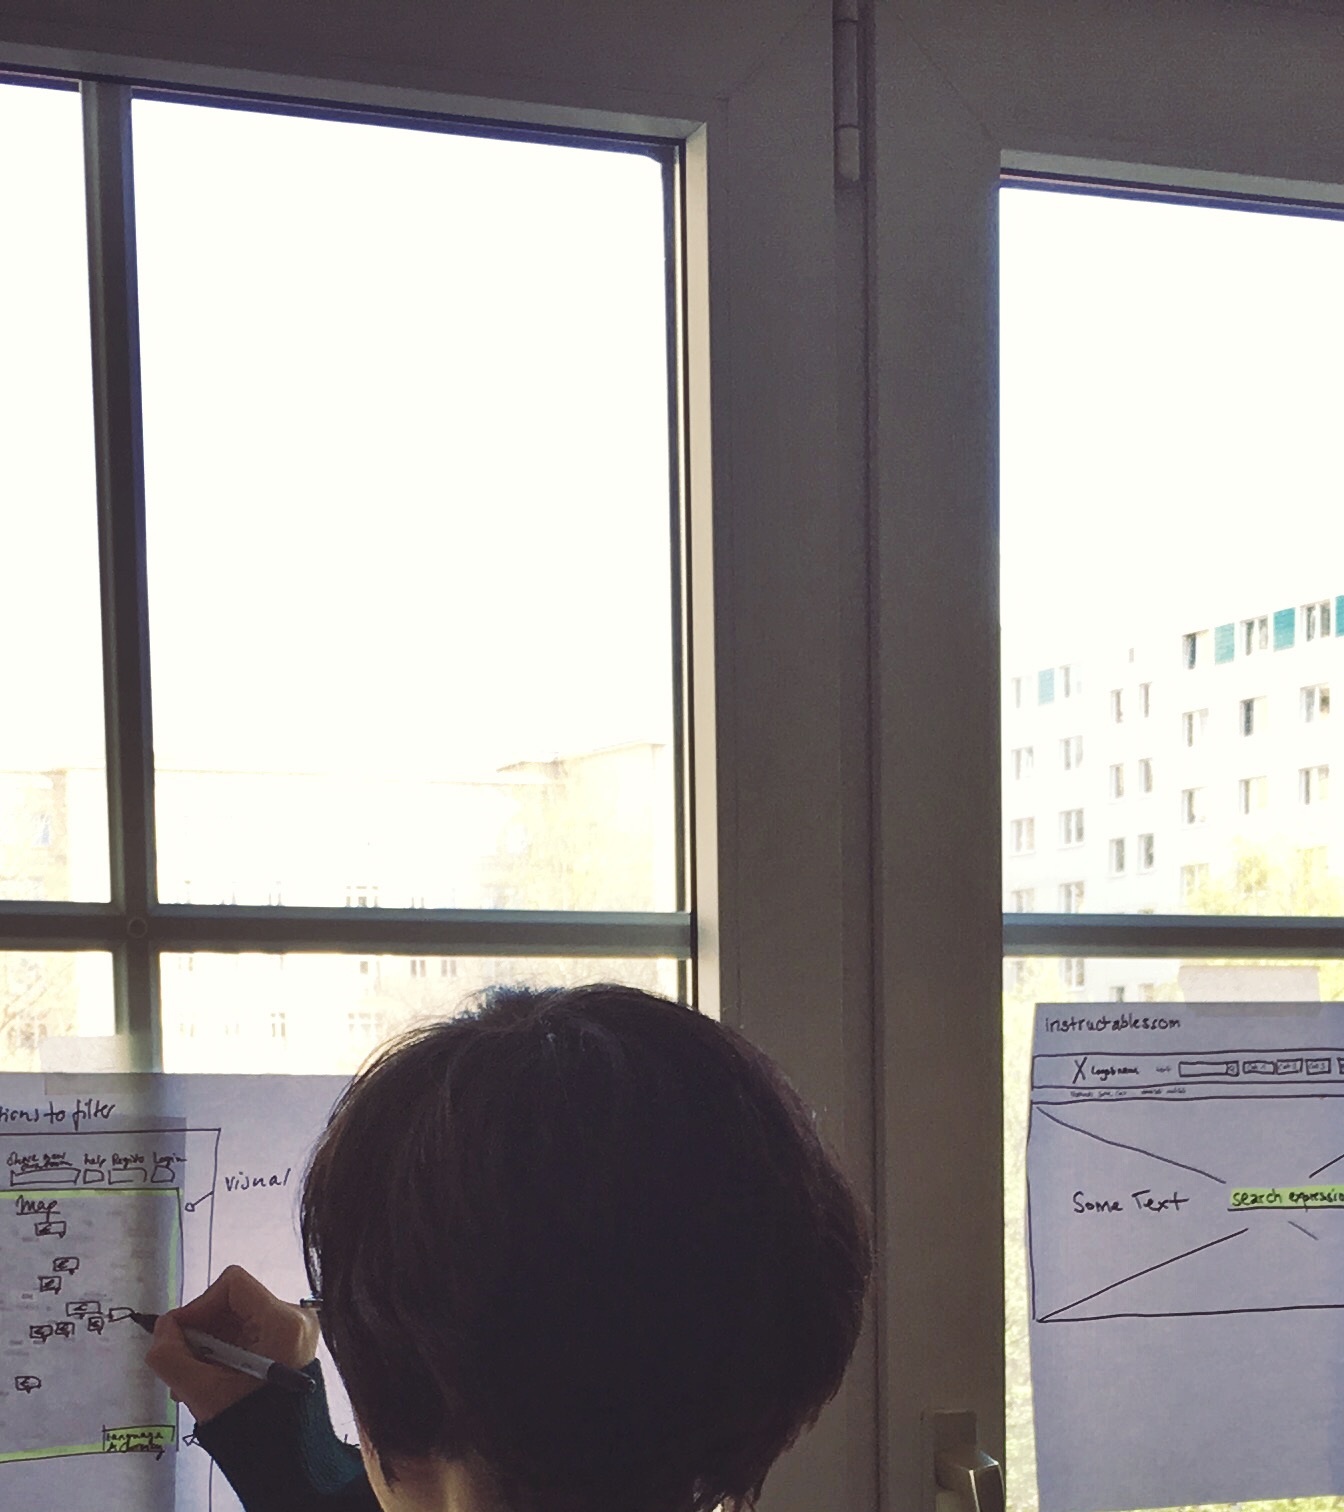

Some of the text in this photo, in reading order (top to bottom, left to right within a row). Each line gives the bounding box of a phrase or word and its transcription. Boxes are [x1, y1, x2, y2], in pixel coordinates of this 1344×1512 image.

[40, 1101, 66, 1123] to
[74, 1099, 116, 1131] filter
[1072, 1189, 1190, 1214] Some Text
[1231, 1188, 1282, 1206] search
